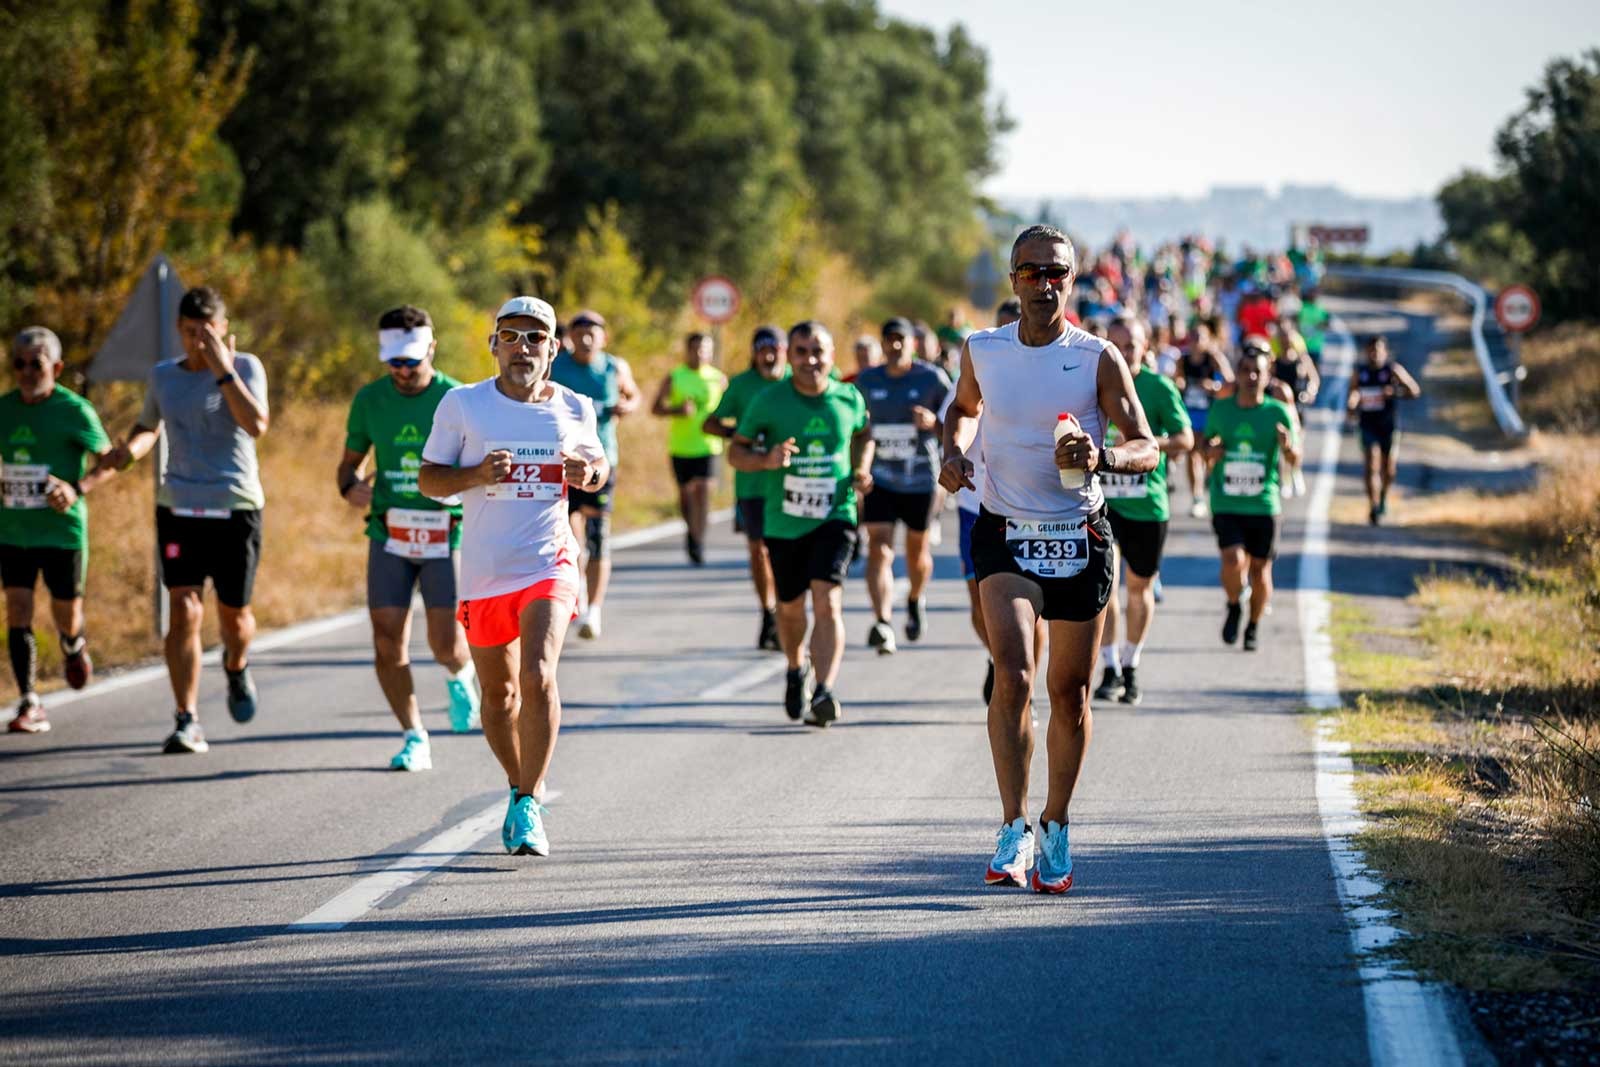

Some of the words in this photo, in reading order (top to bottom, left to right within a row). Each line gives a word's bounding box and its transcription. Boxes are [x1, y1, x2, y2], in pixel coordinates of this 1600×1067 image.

[511, 464, 541, 483] 42
[405, 529, 431, 543] 10
[1018, 540, 1078, 559] 1339
